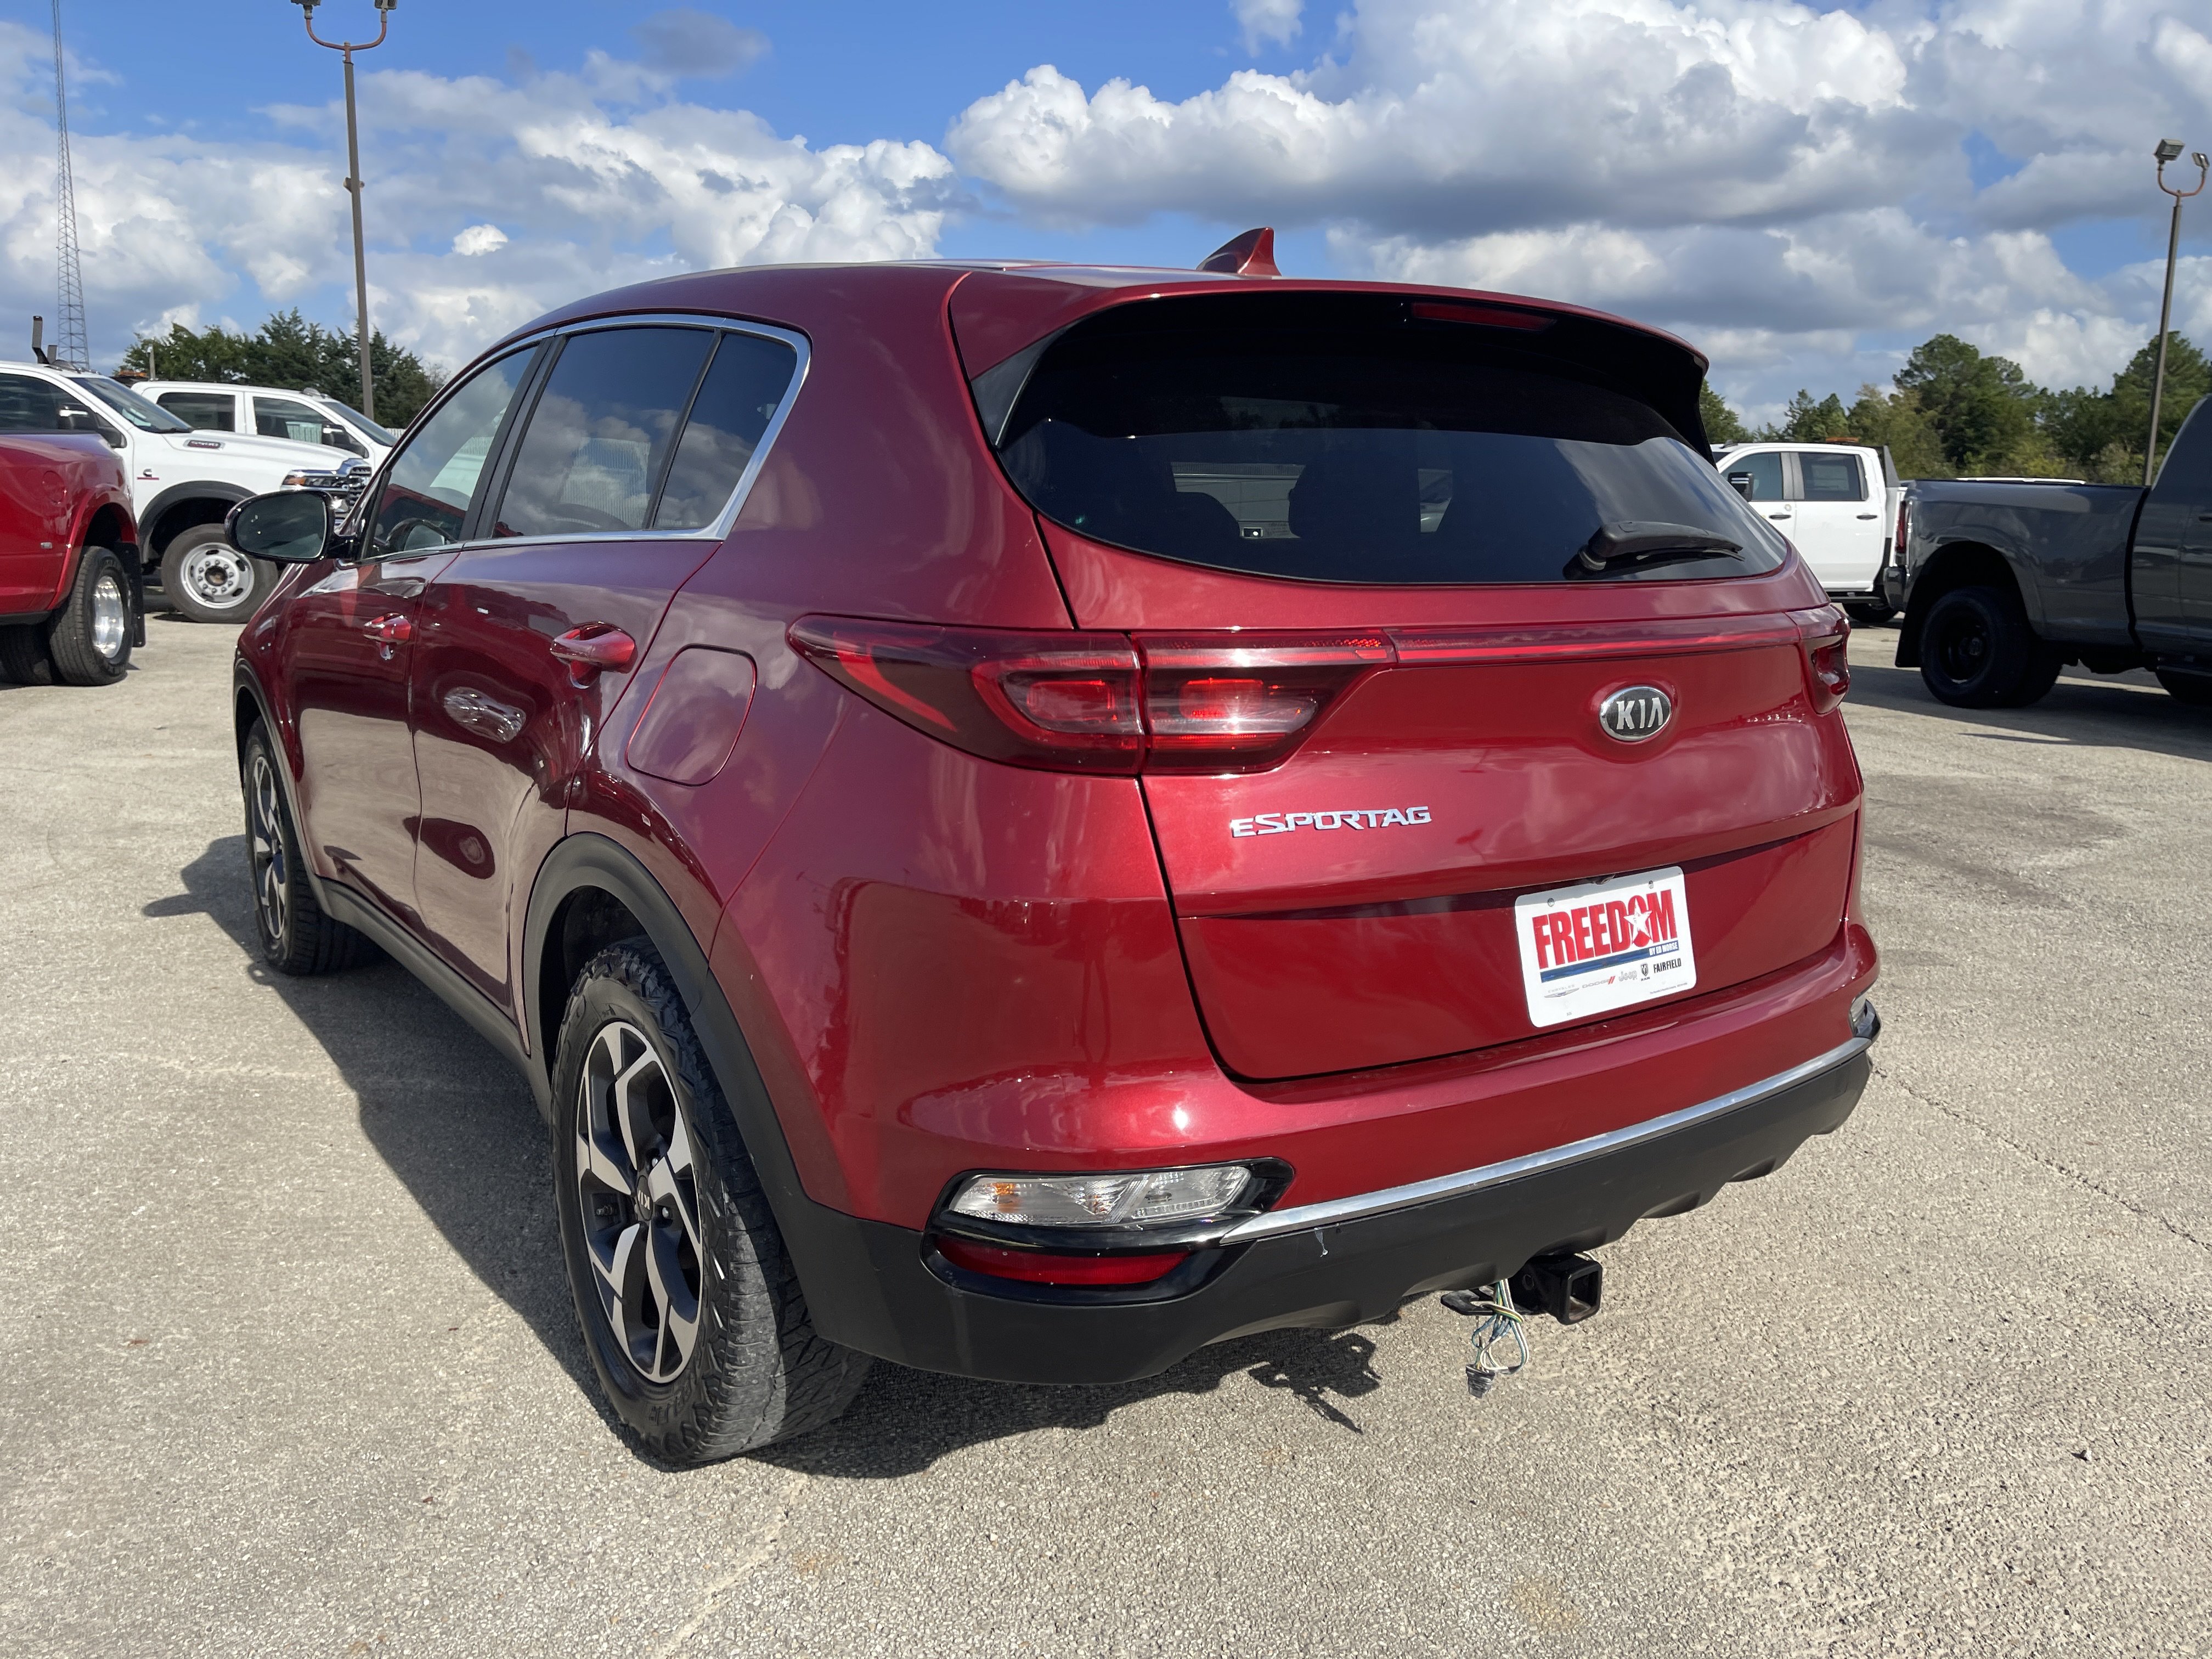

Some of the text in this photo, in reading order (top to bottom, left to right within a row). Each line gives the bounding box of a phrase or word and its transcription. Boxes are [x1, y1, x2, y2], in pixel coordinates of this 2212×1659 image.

[1616, 697, 1663, 730] KIA
[1229, 806, 1432, 837] ESPORTAG
[1532, 889, 1678, 969] FREEDOM
[1649, 947, 1656, 955] BY
[1662, 942, 1678, 952] MORSE
[1653, 958, 1681, 973] FAIRFIELD
[1618, 970, 1637, 981] Jeep
[1548, 984, 1575, 994] CHRYSLER
